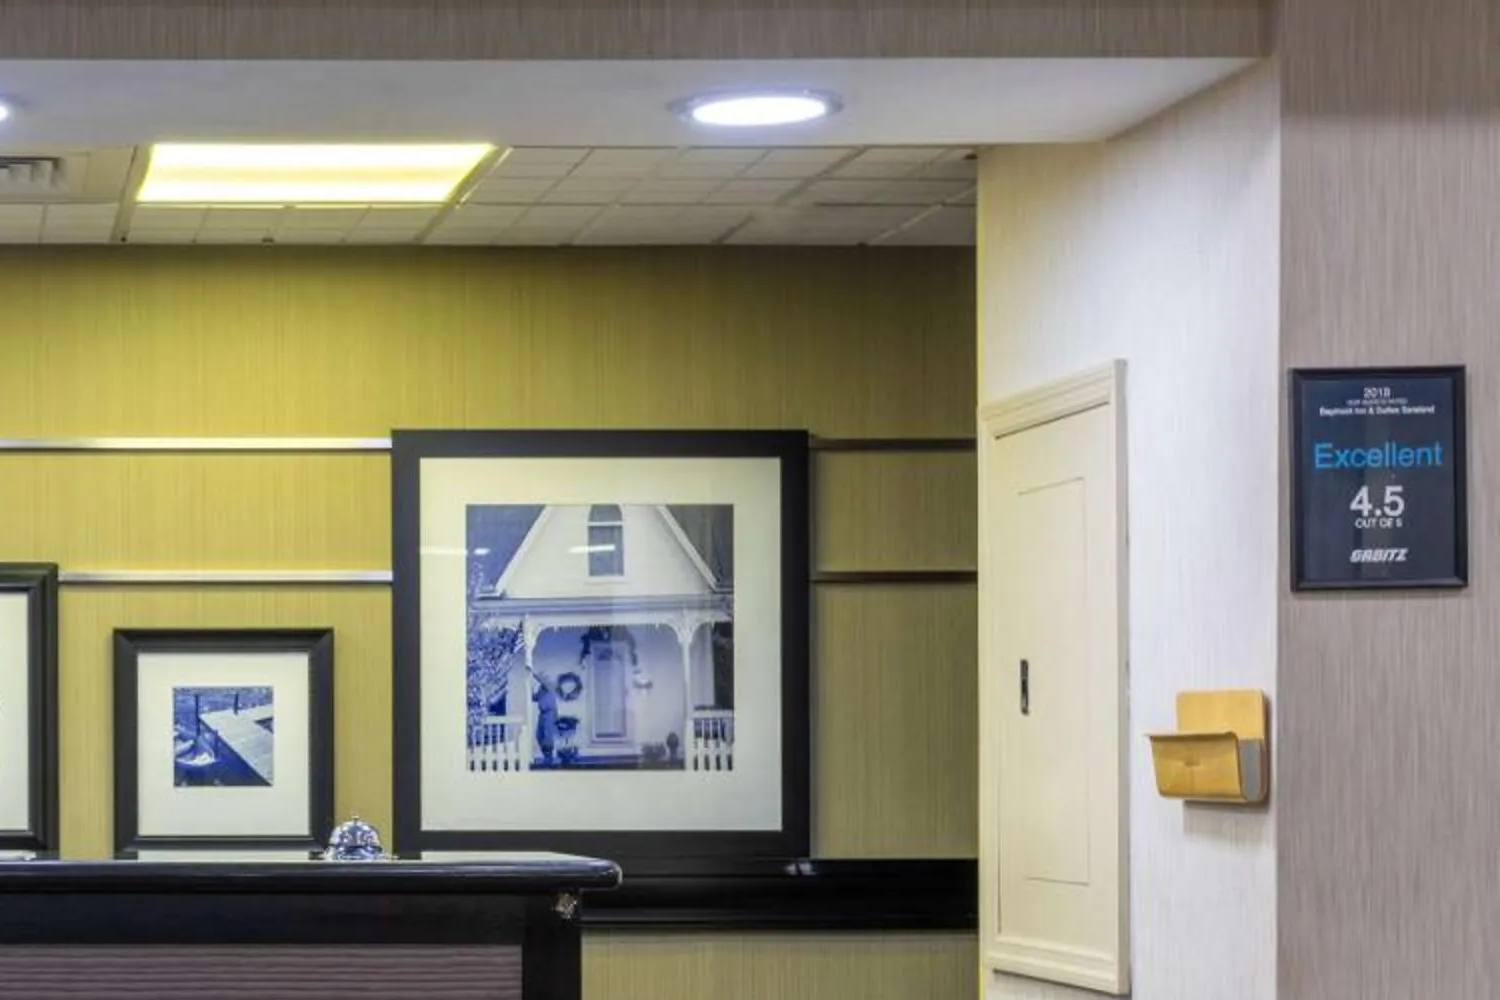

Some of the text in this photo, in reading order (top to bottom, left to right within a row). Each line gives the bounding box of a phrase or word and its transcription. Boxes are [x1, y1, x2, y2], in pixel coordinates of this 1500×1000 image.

[1314, 442, 1443, 469] Excellent
[1350, 485, 1405, 517] 4.5
[1354, 517, 1376, 529] OUT
[1349, 547, 1409, 562] ORBITZ
